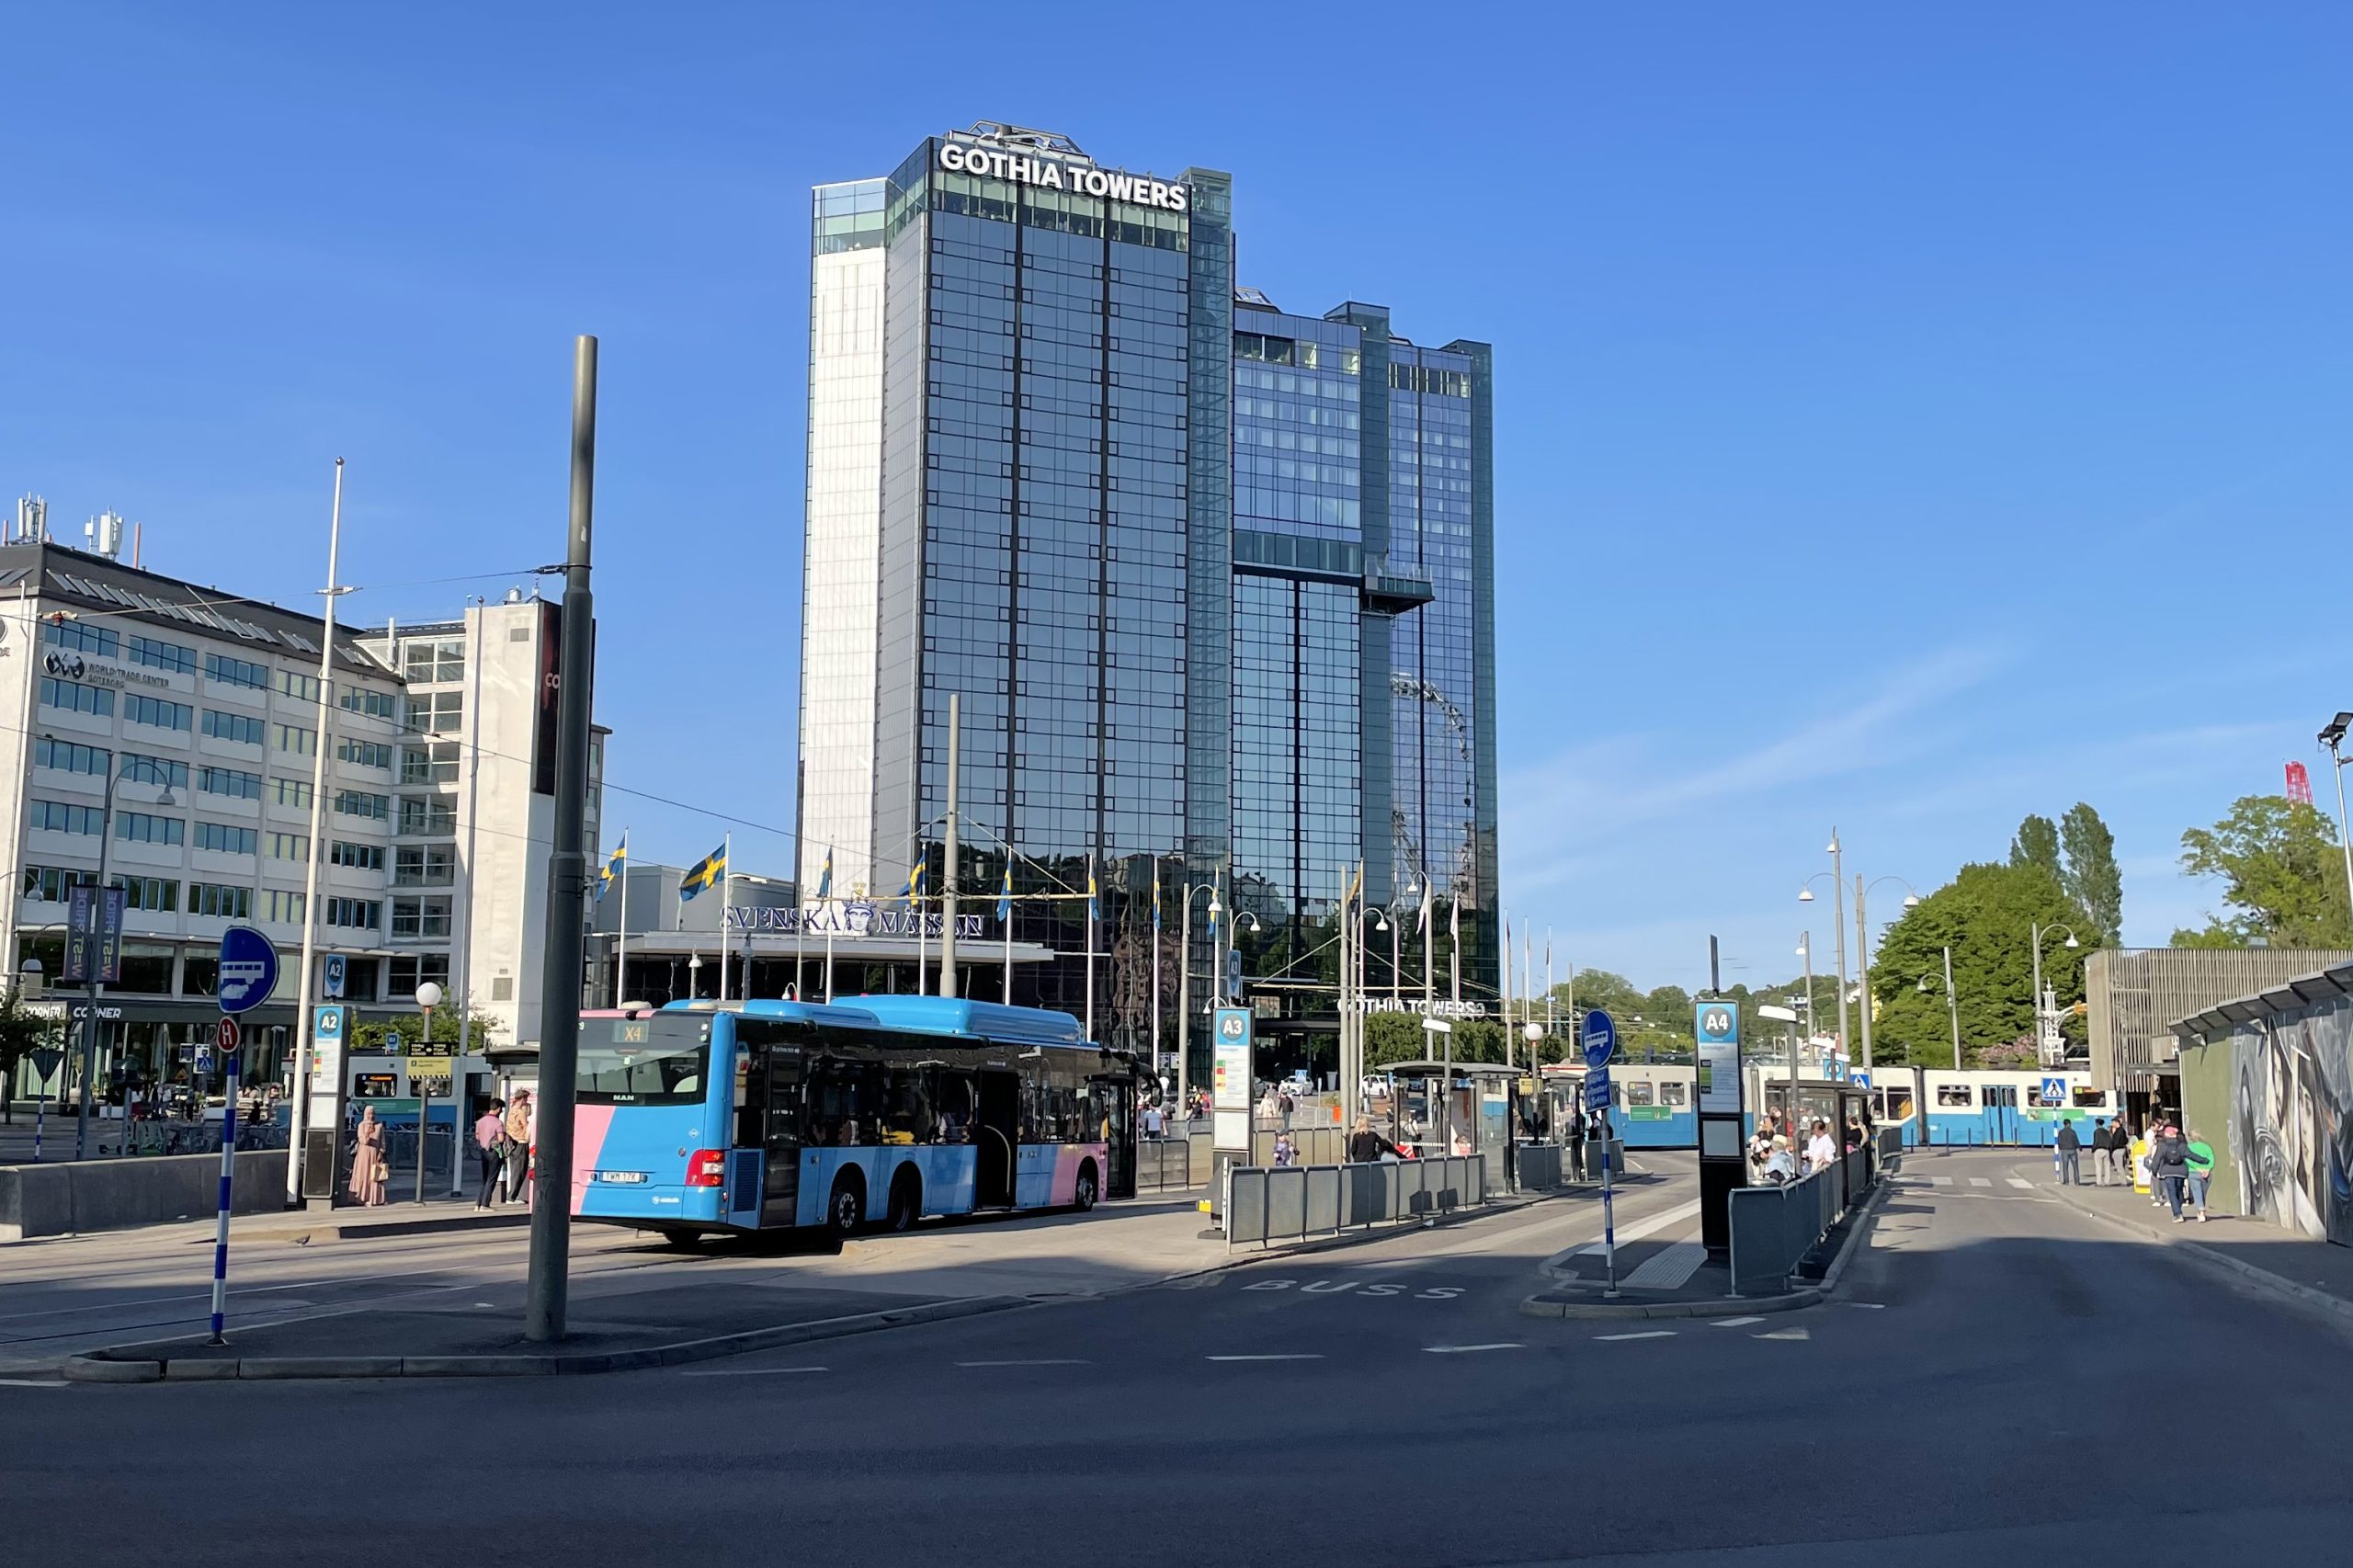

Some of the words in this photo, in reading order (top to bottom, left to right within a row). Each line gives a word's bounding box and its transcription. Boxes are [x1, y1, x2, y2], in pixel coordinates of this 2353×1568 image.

[939, 143, 1063, 189] GOTHIA
[1068, 166, 1187, 211] TOWERS
[87, 663, 115, 677] WORLD
[116, 668, 141, 683] TRADE
[142, 674, 170, 688] CENTER
[720, 905, 841, 931] SVENSKA
[329, 963, 341, 976] A2
[1230, 960, 1238, 975] A3
[73, 1006, 121, 1018] CONER
[322, 1015, 337, 1028] A2
[1222, 1019, 1243, 1035] A3
[1705, 1014, 1729, 1030] A4
[222, 1024, 233, 1045] H
[624, 1026, 641, 1041] X4
[1241, 1278, 1467, 1300] BUSS
